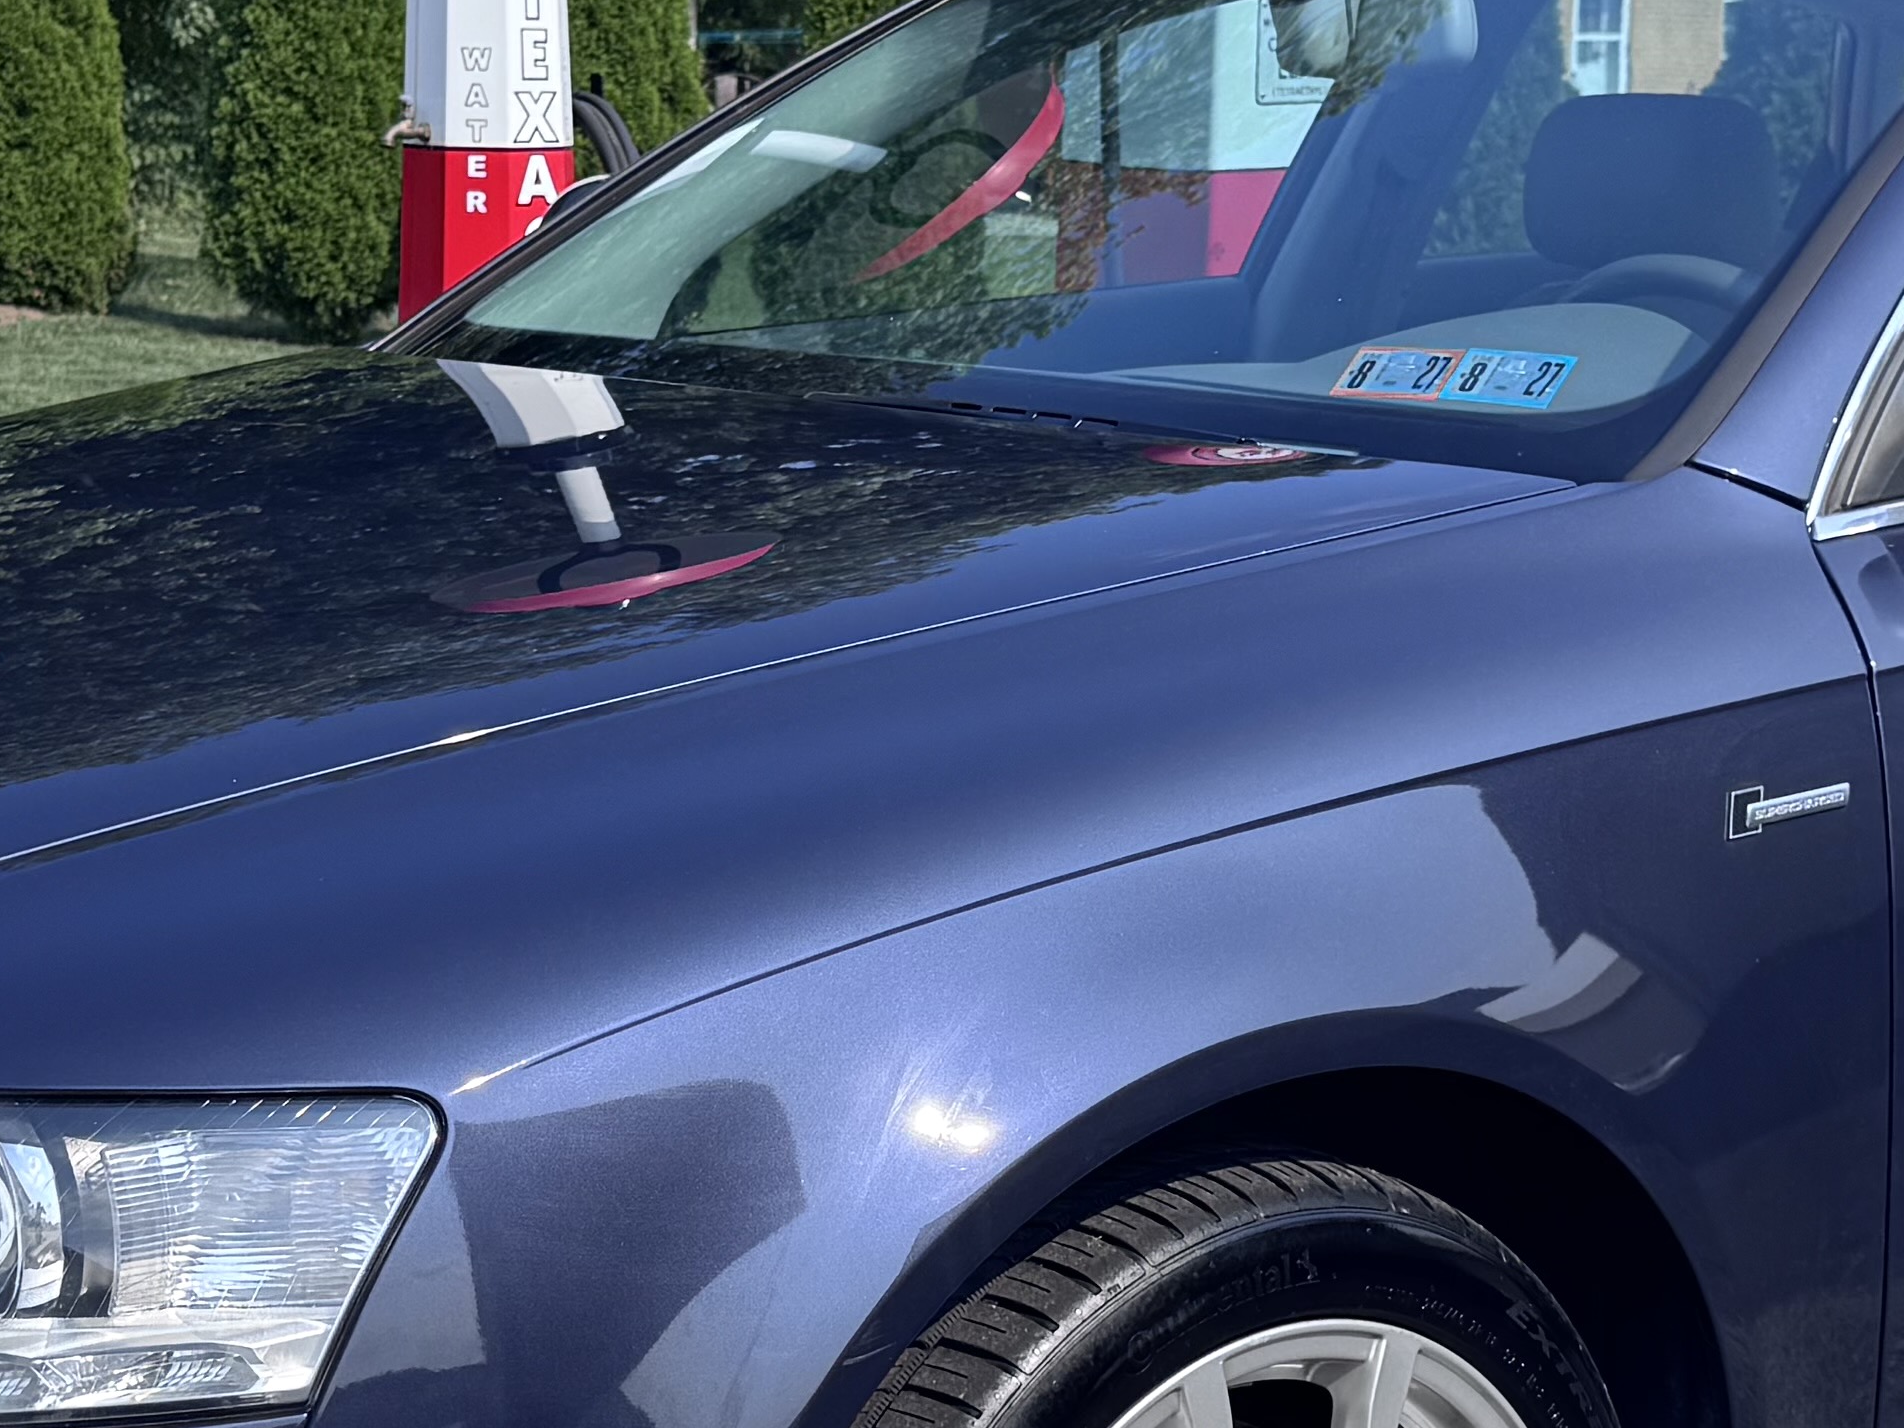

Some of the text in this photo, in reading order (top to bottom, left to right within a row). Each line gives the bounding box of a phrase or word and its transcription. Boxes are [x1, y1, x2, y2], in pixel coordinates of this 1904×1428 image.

[461, 47, 492, 214] WATER
[1411, 356, 1453, 393] 27
[1523, 361, 1566, 397] 27
